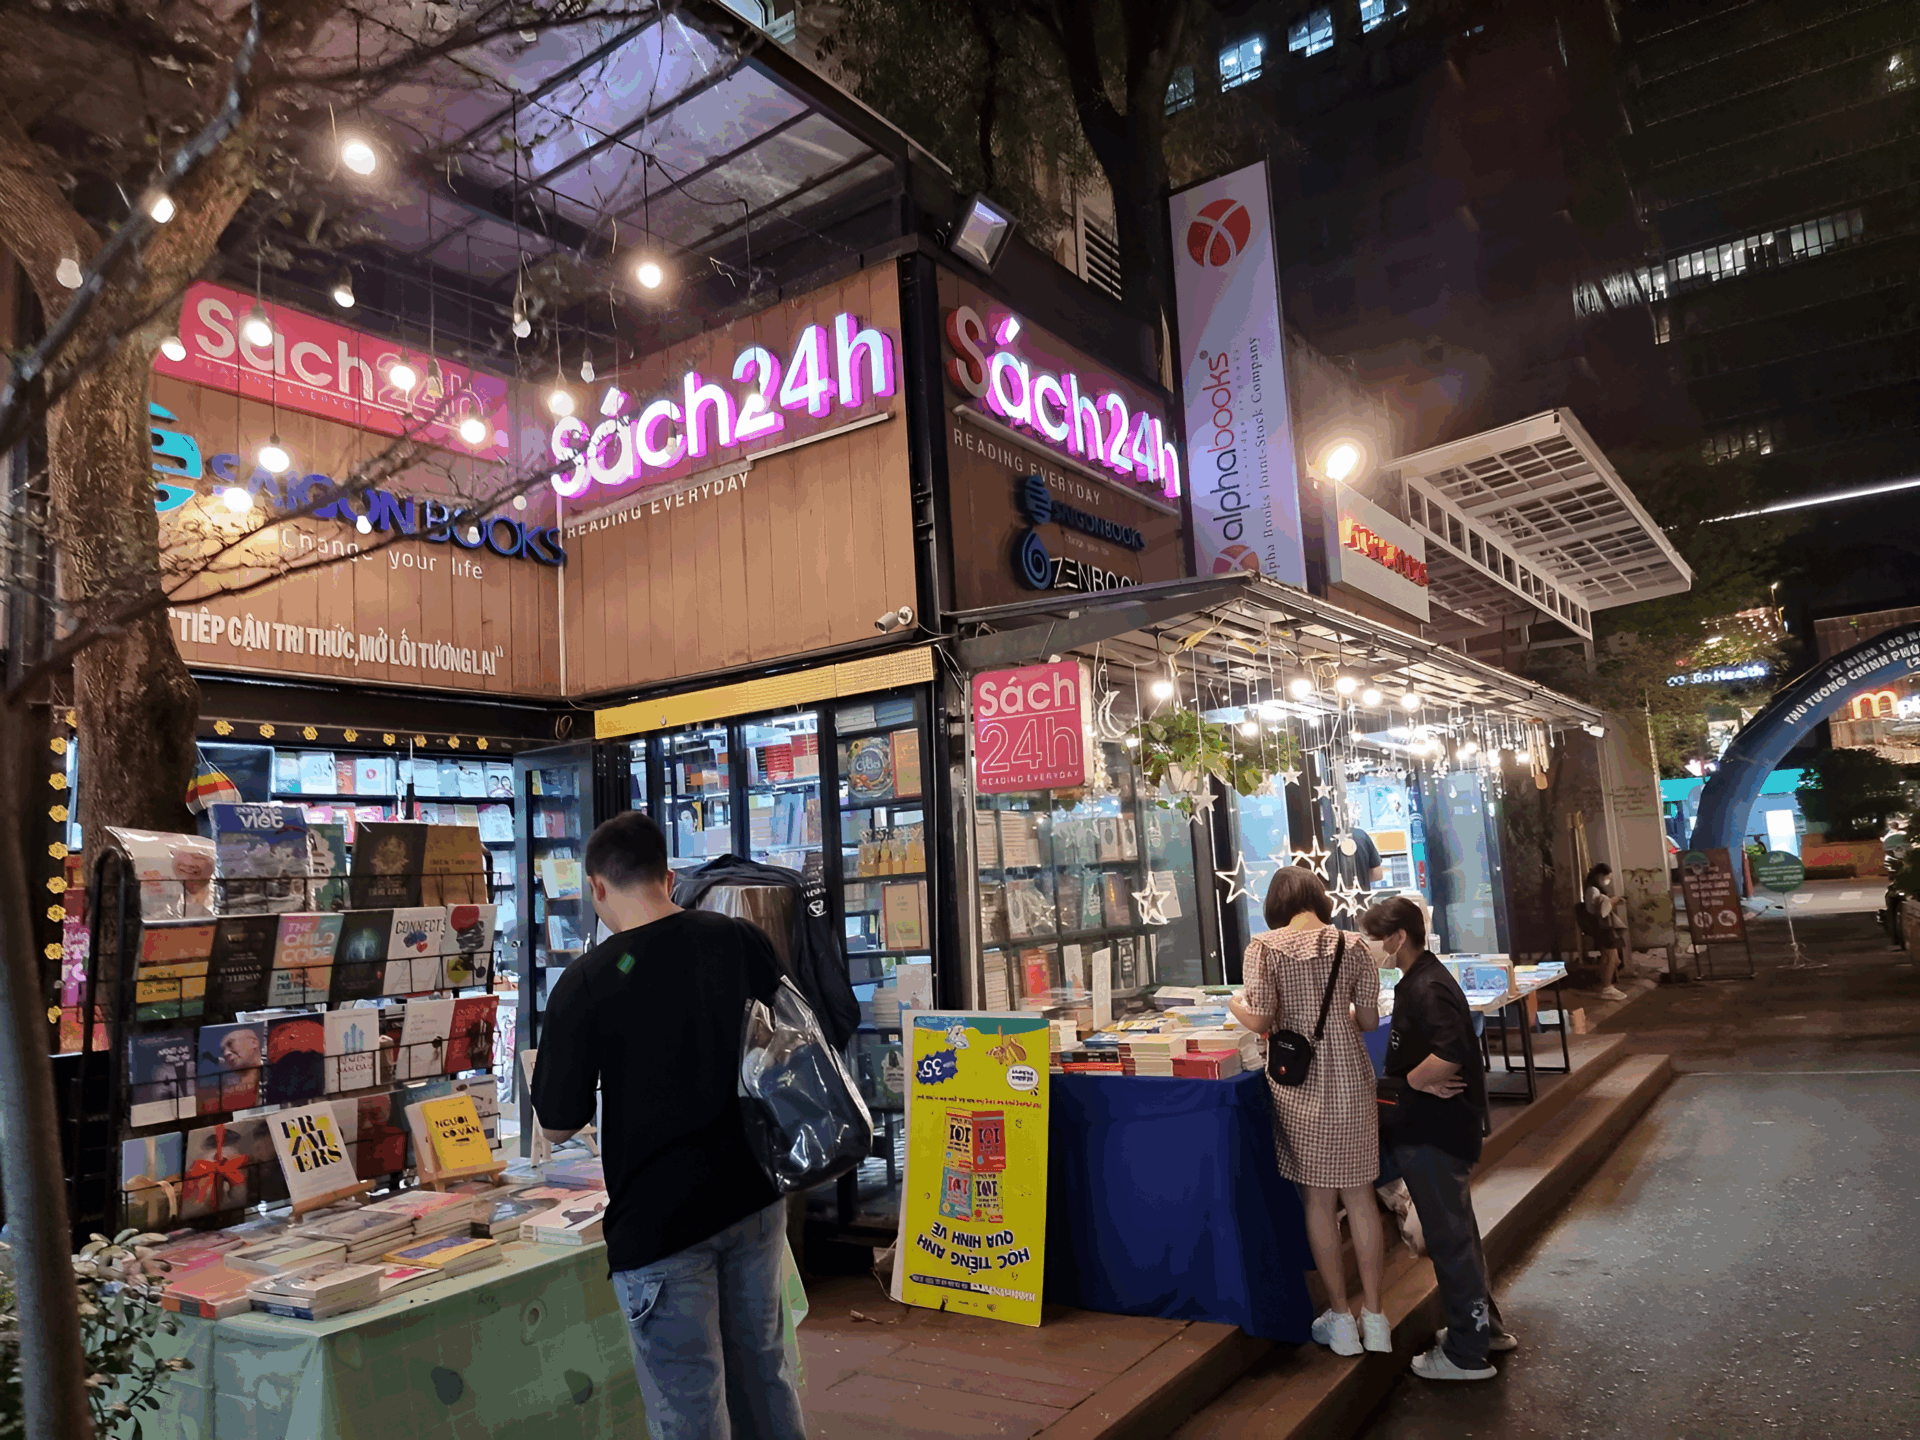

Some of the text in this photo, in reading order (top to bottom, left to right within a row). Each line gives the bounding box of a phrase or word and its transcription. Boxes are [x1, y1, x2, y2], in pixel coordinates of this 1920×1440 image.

[946, 305, 1182, 498] Sách24h
[954, 428, 1100, 505] READING EVERYDAY
[1202, 352, 1250, 541] alphabooks
[567, 471, 751, 539] READING EVERYDAY
[387, 548, 438, 571] your
[452, 556, 484, 580] life
[1050, 557, 1144, 593] ZENBOO
[272, 622, 304, 654] TRI
[979, 671, 1076, 717] Sách
[979, 716, 1079, 774] 24h
[916, 1233, 947, 1260] ANH
[985, 1229, 1015, 1249] QUA
[996, 1246, 1032, 1270] HỌC
